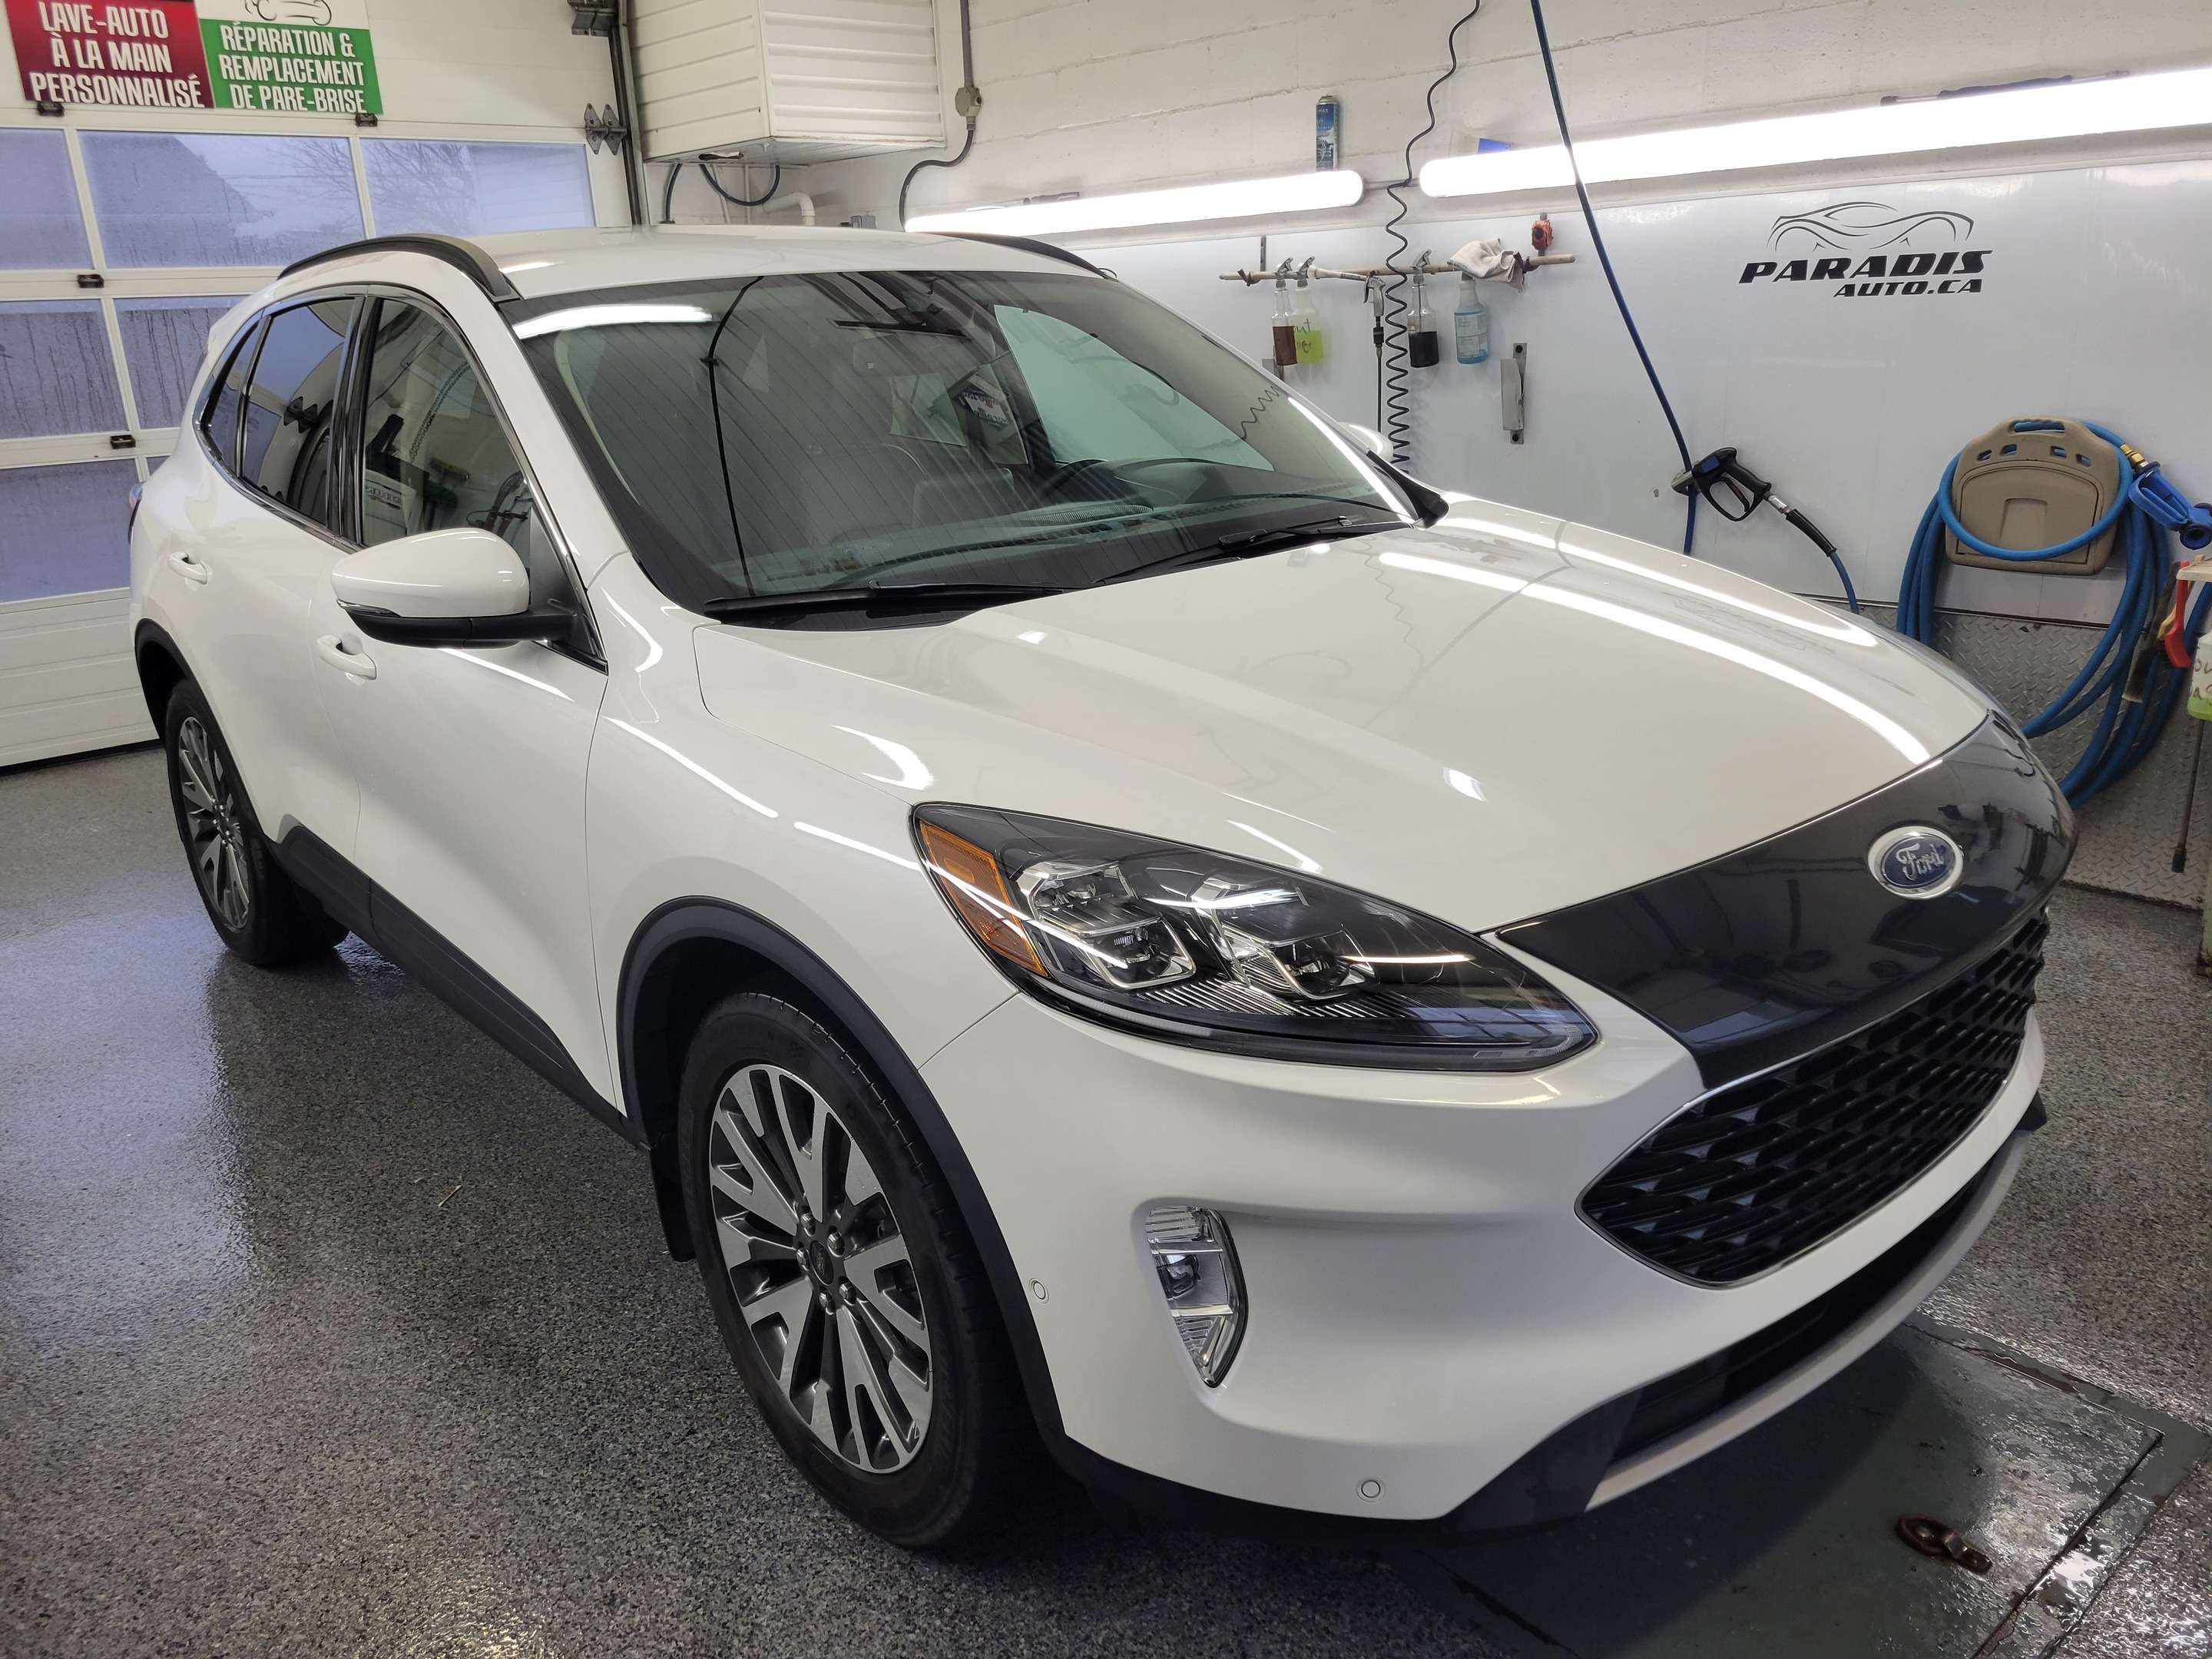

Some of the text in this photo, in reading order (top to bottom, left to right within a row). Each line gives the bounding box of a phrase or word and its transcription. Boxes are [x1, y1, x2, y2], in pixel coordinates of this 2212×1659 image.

[39, 2, 169, 38] LAVE-AUTO
[51, 31, 173, 73] À LA MAIN
[220, 21, 356, 58] RÉPARATION &
[218, 54, 364, 85] REMPLACEMENT
[29, 71, 205, 108] PERSONNALISÉ
[230, 84, 366, 113] DE PARE-BRISE
[1738, 250, 1994, 284] PARADIS
[1833, 279, 1983, 298] AUTO.CA
[1896, 843, 1945, 881] Ford
